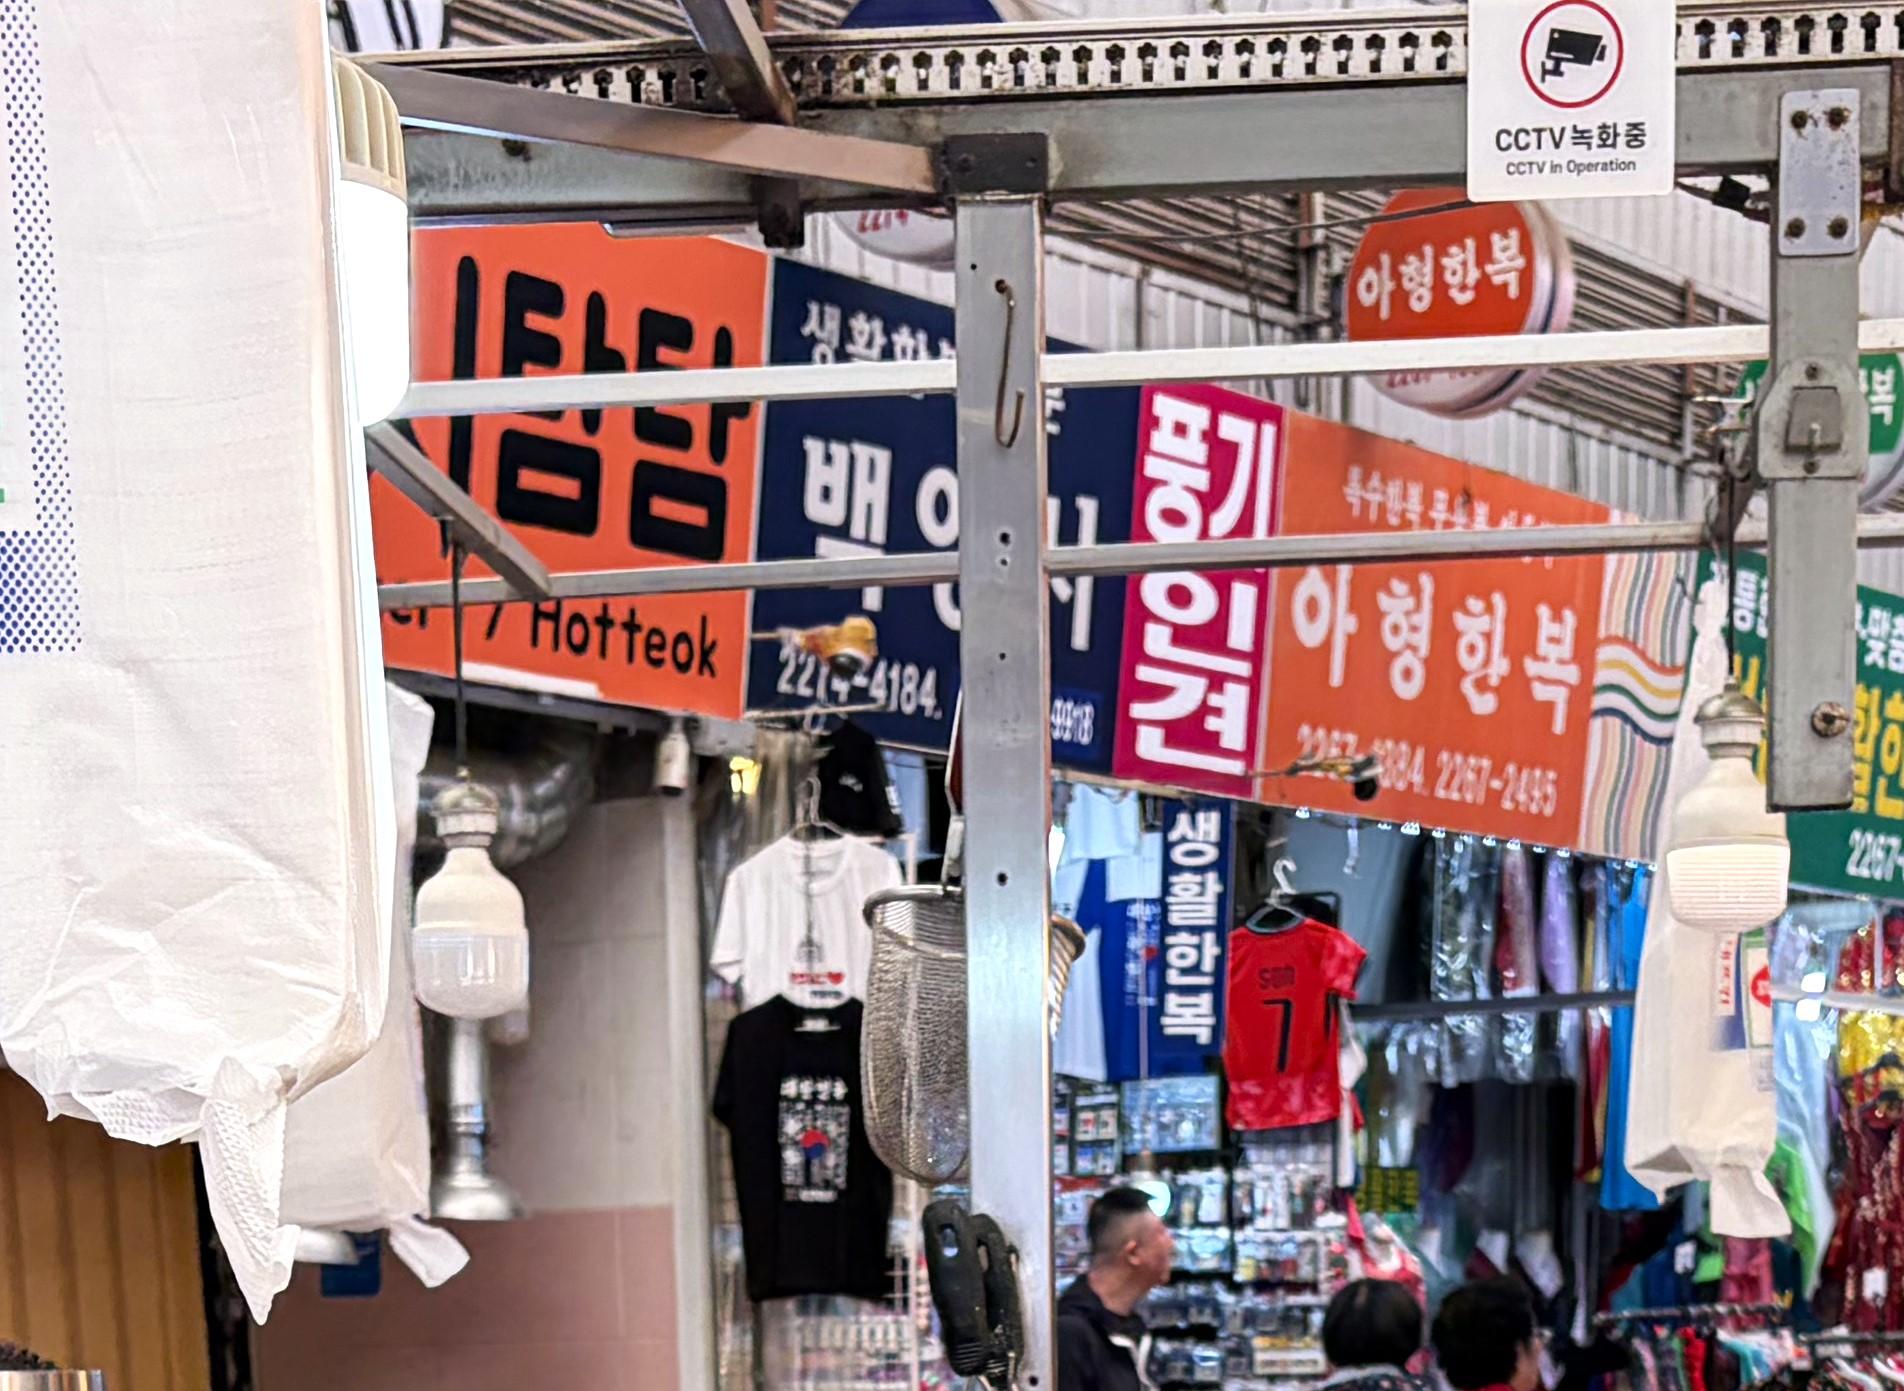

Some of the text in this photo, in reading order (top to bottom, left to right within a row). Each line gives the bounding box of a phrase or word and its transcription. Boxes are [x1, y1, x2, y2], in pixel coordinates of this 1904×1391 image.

[1496, 126, 1567, 152] CCTV
[1506, 156, 1638, 178] CCTV in Operation
[1357, 228, 1527, 322] 아형한복
[530, 598, 718, 680] Hotteok
[1290, 562, 1582, 736] 아형한복
[1160, 808, 1225, 1046] 생활한복
[1263, 998, 1294, 1074] 7
